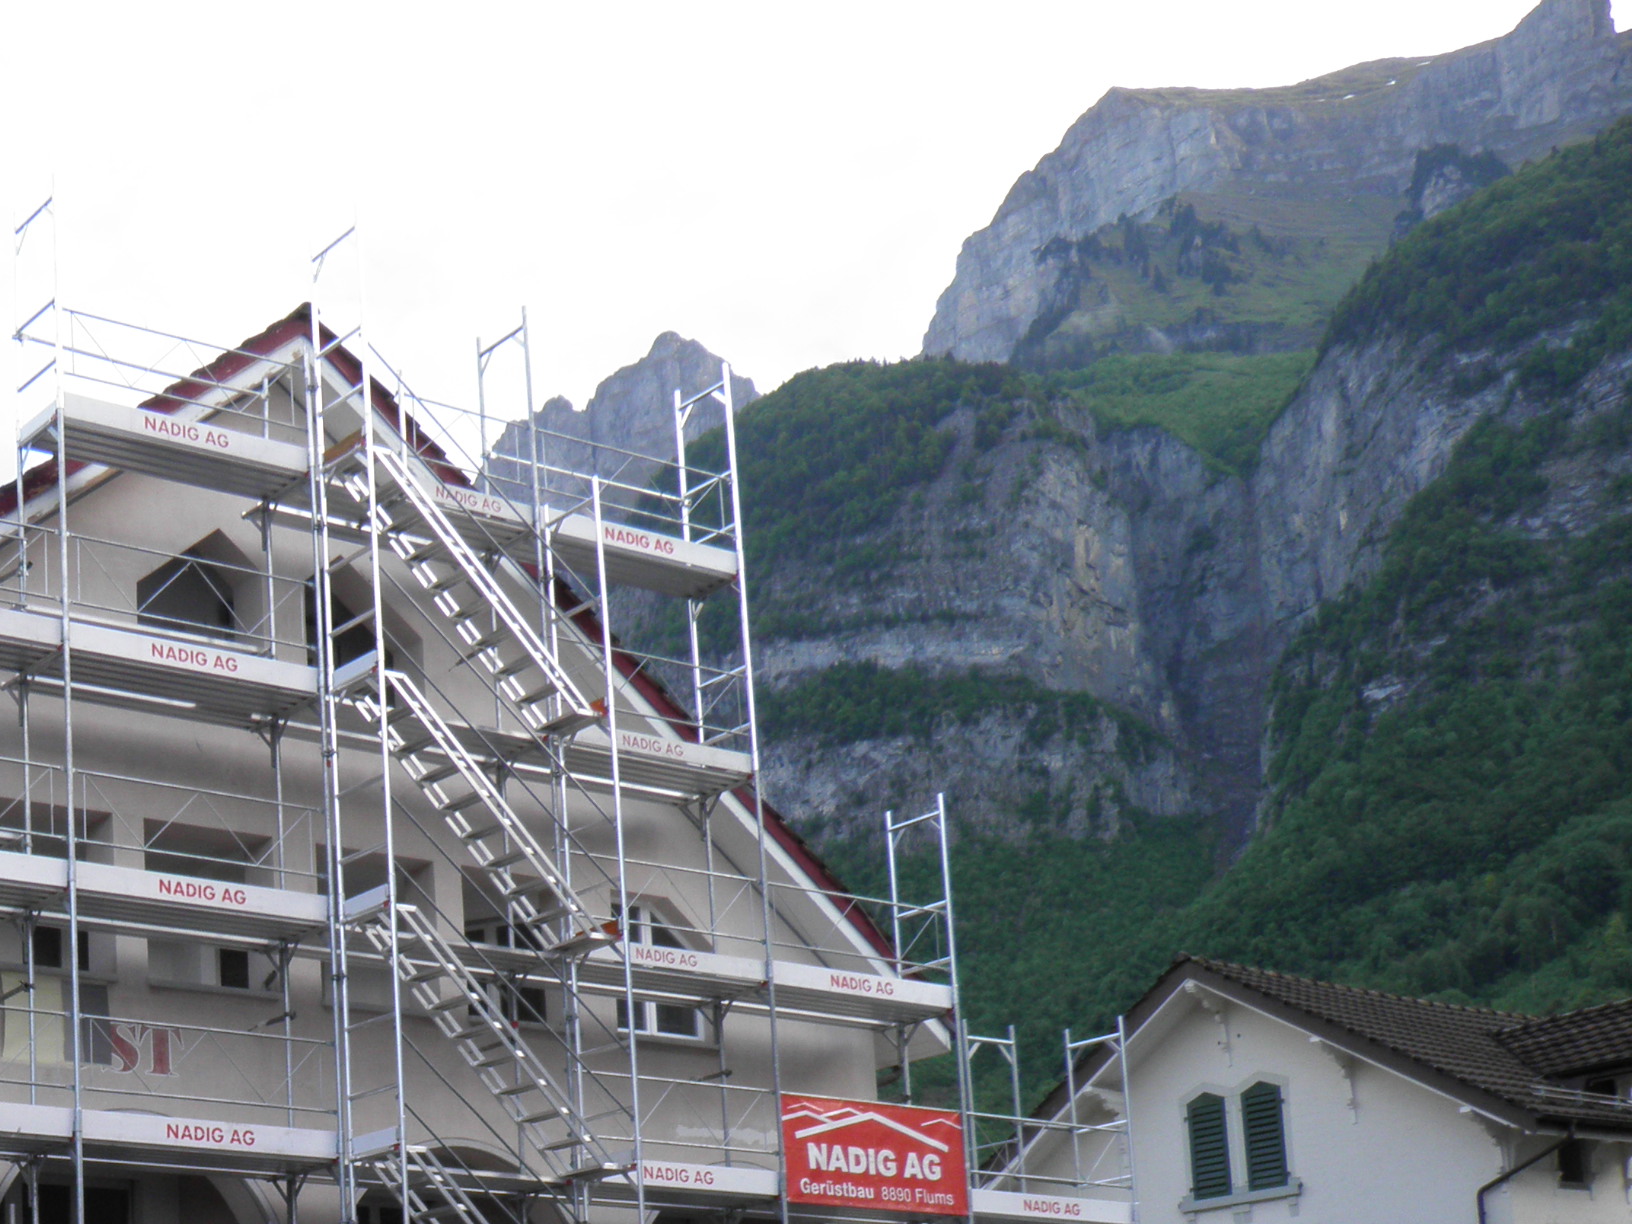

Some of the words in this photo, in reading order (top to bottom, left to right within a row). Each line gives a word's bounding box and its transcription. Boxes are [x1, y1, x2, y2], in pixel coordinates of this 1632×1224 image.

[144, 416, 199, 441] NADIG
[205, 431, 229, 448] AG
[605, 527, 650, 549] NADIG
[654, 539, 674, 555] AG
[151, 643, 207, 667] NADIG
[213, 655, 238, 672] AG
[623, 734, 662, 752] NADIG
[665, 742, 684, 757] AG
[159, 880, 216, 901] NADIG
[222, 889, 247, 905] AG
[636, 948, 675, 964] NADIG
[679, 954, 698, 967] AG
[830, 974, 872, 992] NADIG
[876, 981, 894, 995] AG
[166, 1124, 225, 1144] NADIG
[230, 1130, 255, 1147] AG
[807, 1142, 898, 1177] NADIG
[904, 1152, 943, 1181] AG
[644, 1166, 690, 1183] NADIG
[694, 1171, 714, 1185] AG
[799, 1177, 875, 1200] Gerüstbau
[881, 1186, 912, 1202] 8890
[915, 1188, 955, 1206] Flums
[1024, 1200, 1061, 1214] NADIG
[1064, 1203, 1081, 1216] AG
